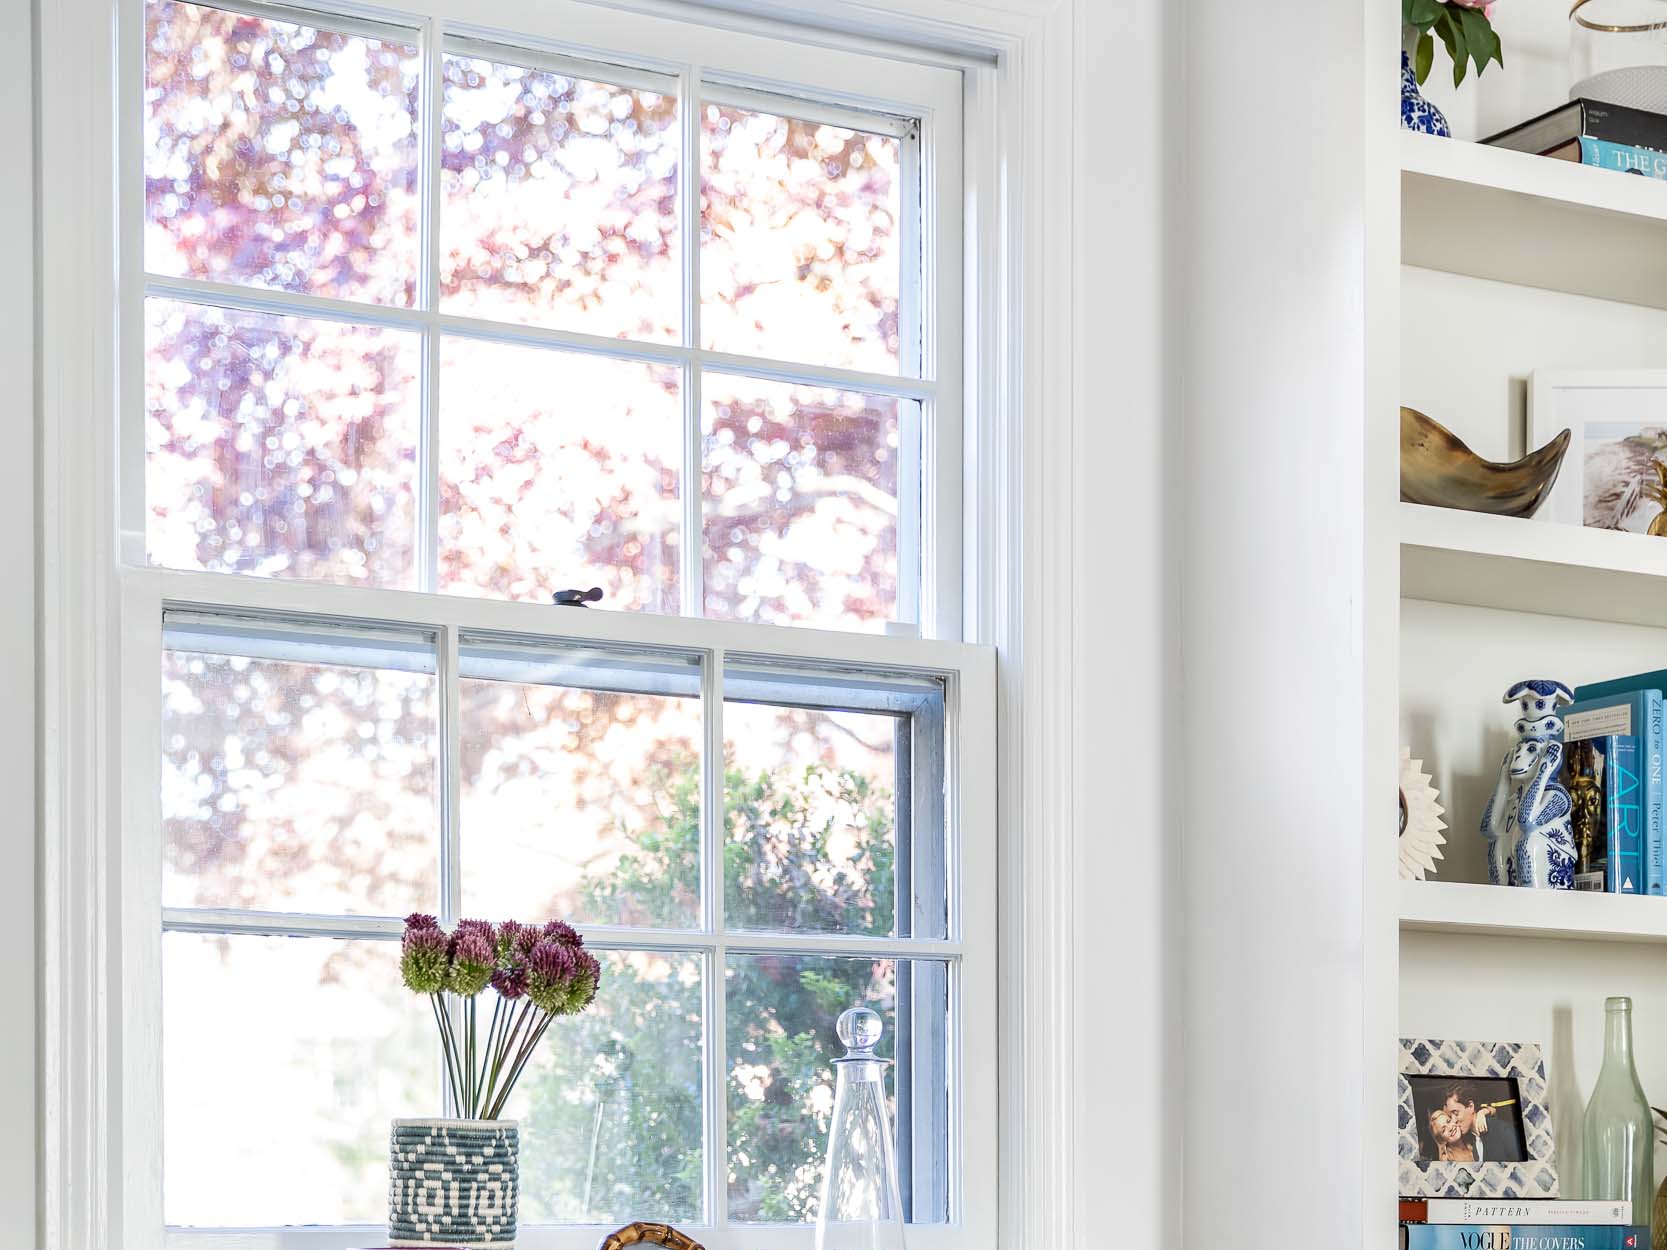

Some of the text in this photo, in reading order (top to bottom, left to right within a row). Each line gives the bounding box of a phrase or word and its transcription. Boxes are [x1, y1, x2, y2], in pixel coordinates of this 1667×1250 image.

[1612, 150, 1651, 172] THE
[1652, 699, 1662, 735] ZERO
[1652, 753, 1662, 785] ONE
[1475, 1207, 1531, 1217] PATTERN
[1459, 1231, 1586, 1250] VOGUE THE COVERS
